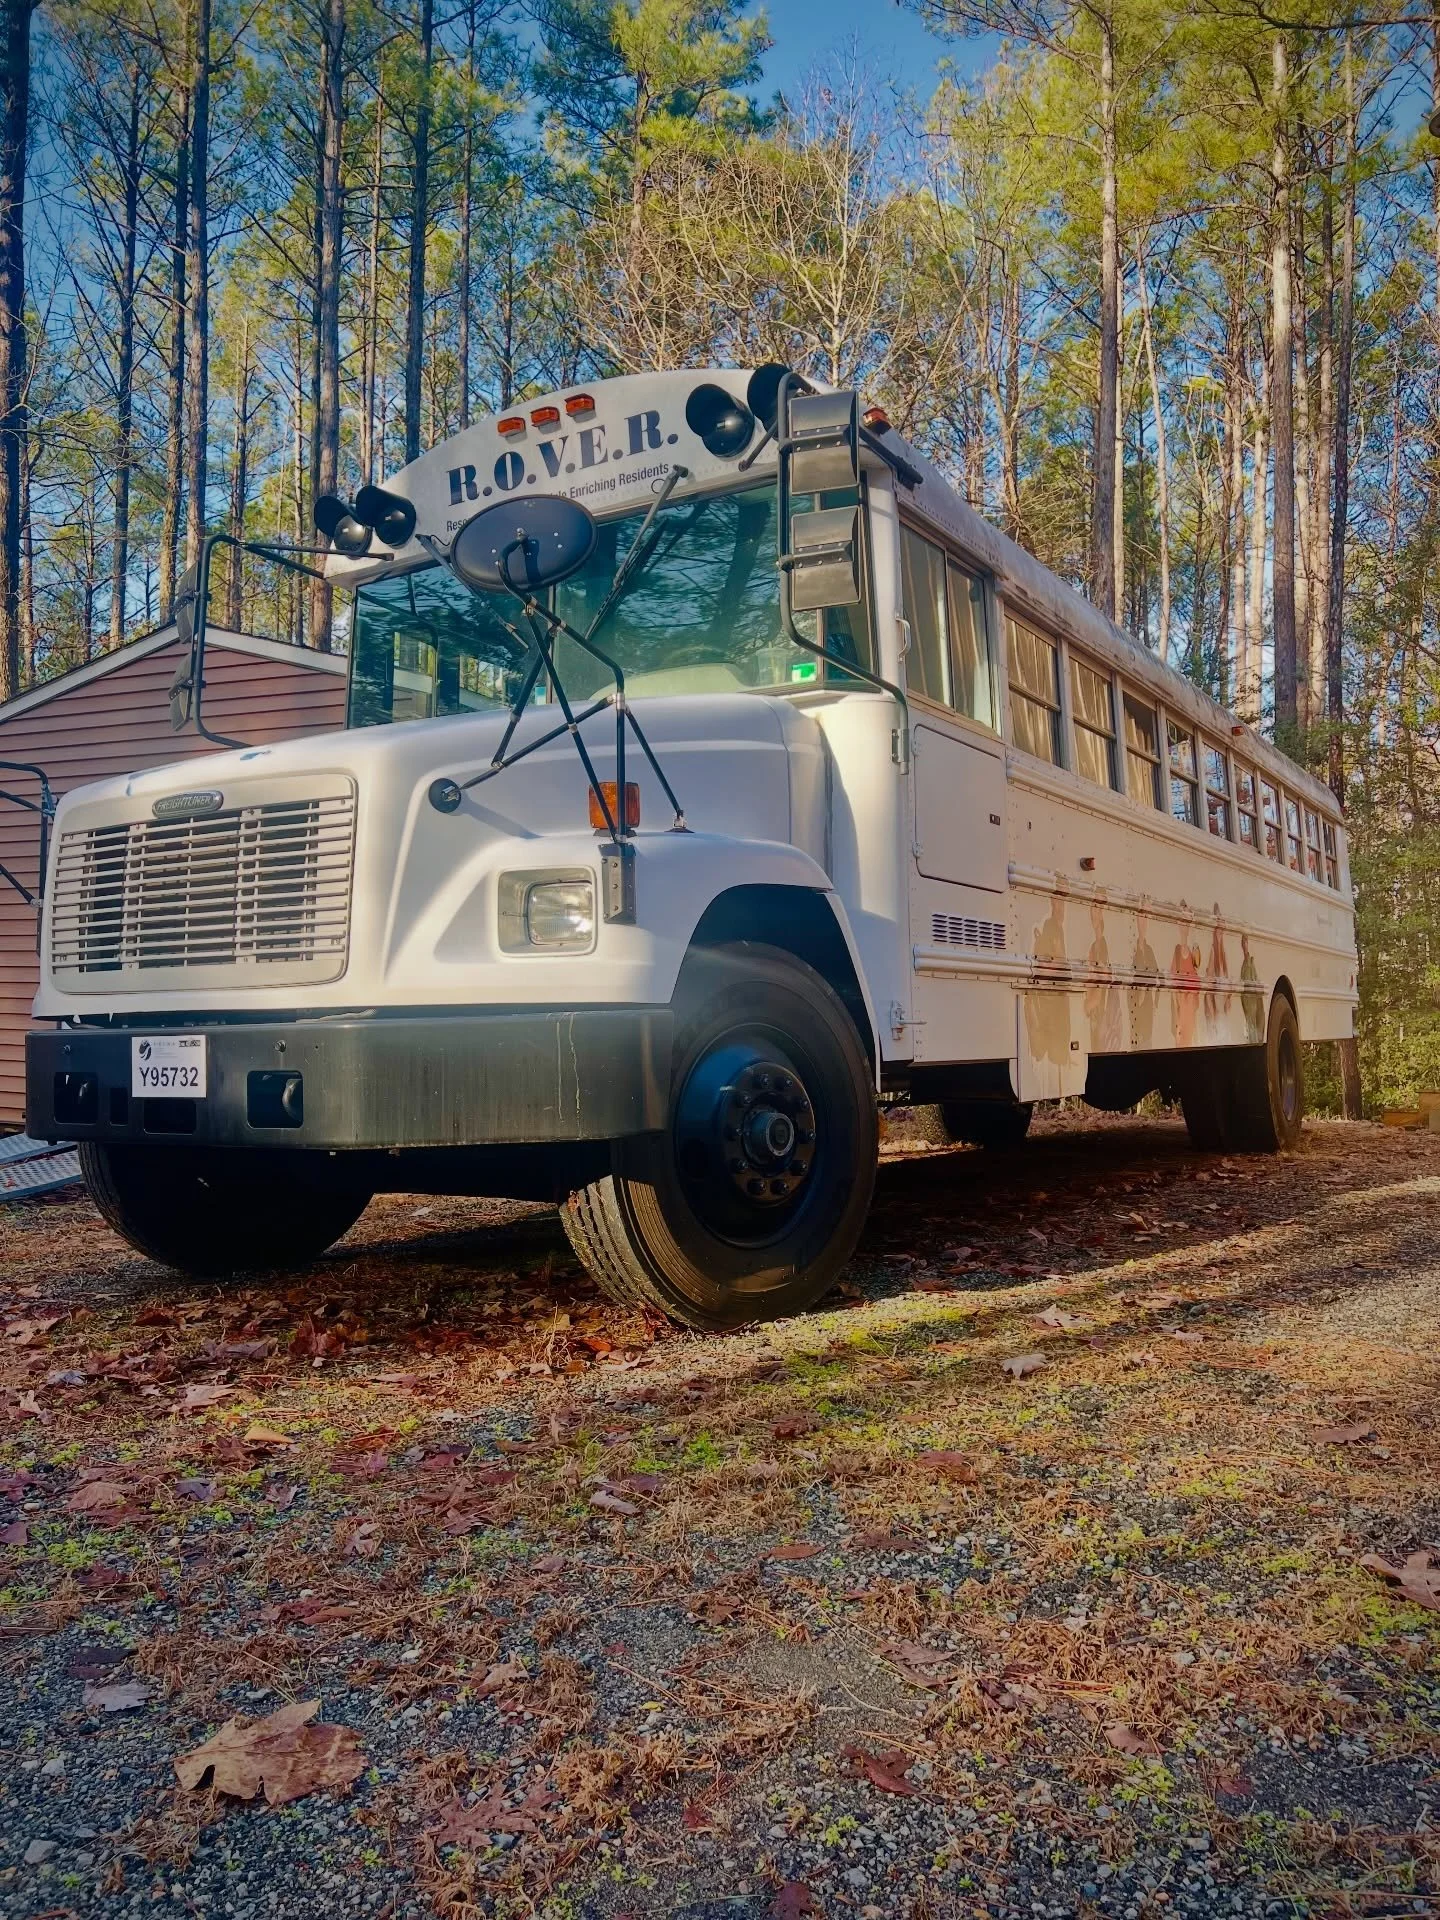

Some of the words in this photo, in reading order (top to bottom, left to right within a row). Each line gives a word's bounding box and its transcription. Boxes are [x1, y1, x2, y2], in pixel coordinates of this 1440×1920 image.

[446, 409, 679, 507] R.O.V.E.R.
[569, 478, 616, 499] Enriching
[619, 462, 670, 486] Residents
[139, 1066, 199, 1087] Y95732
